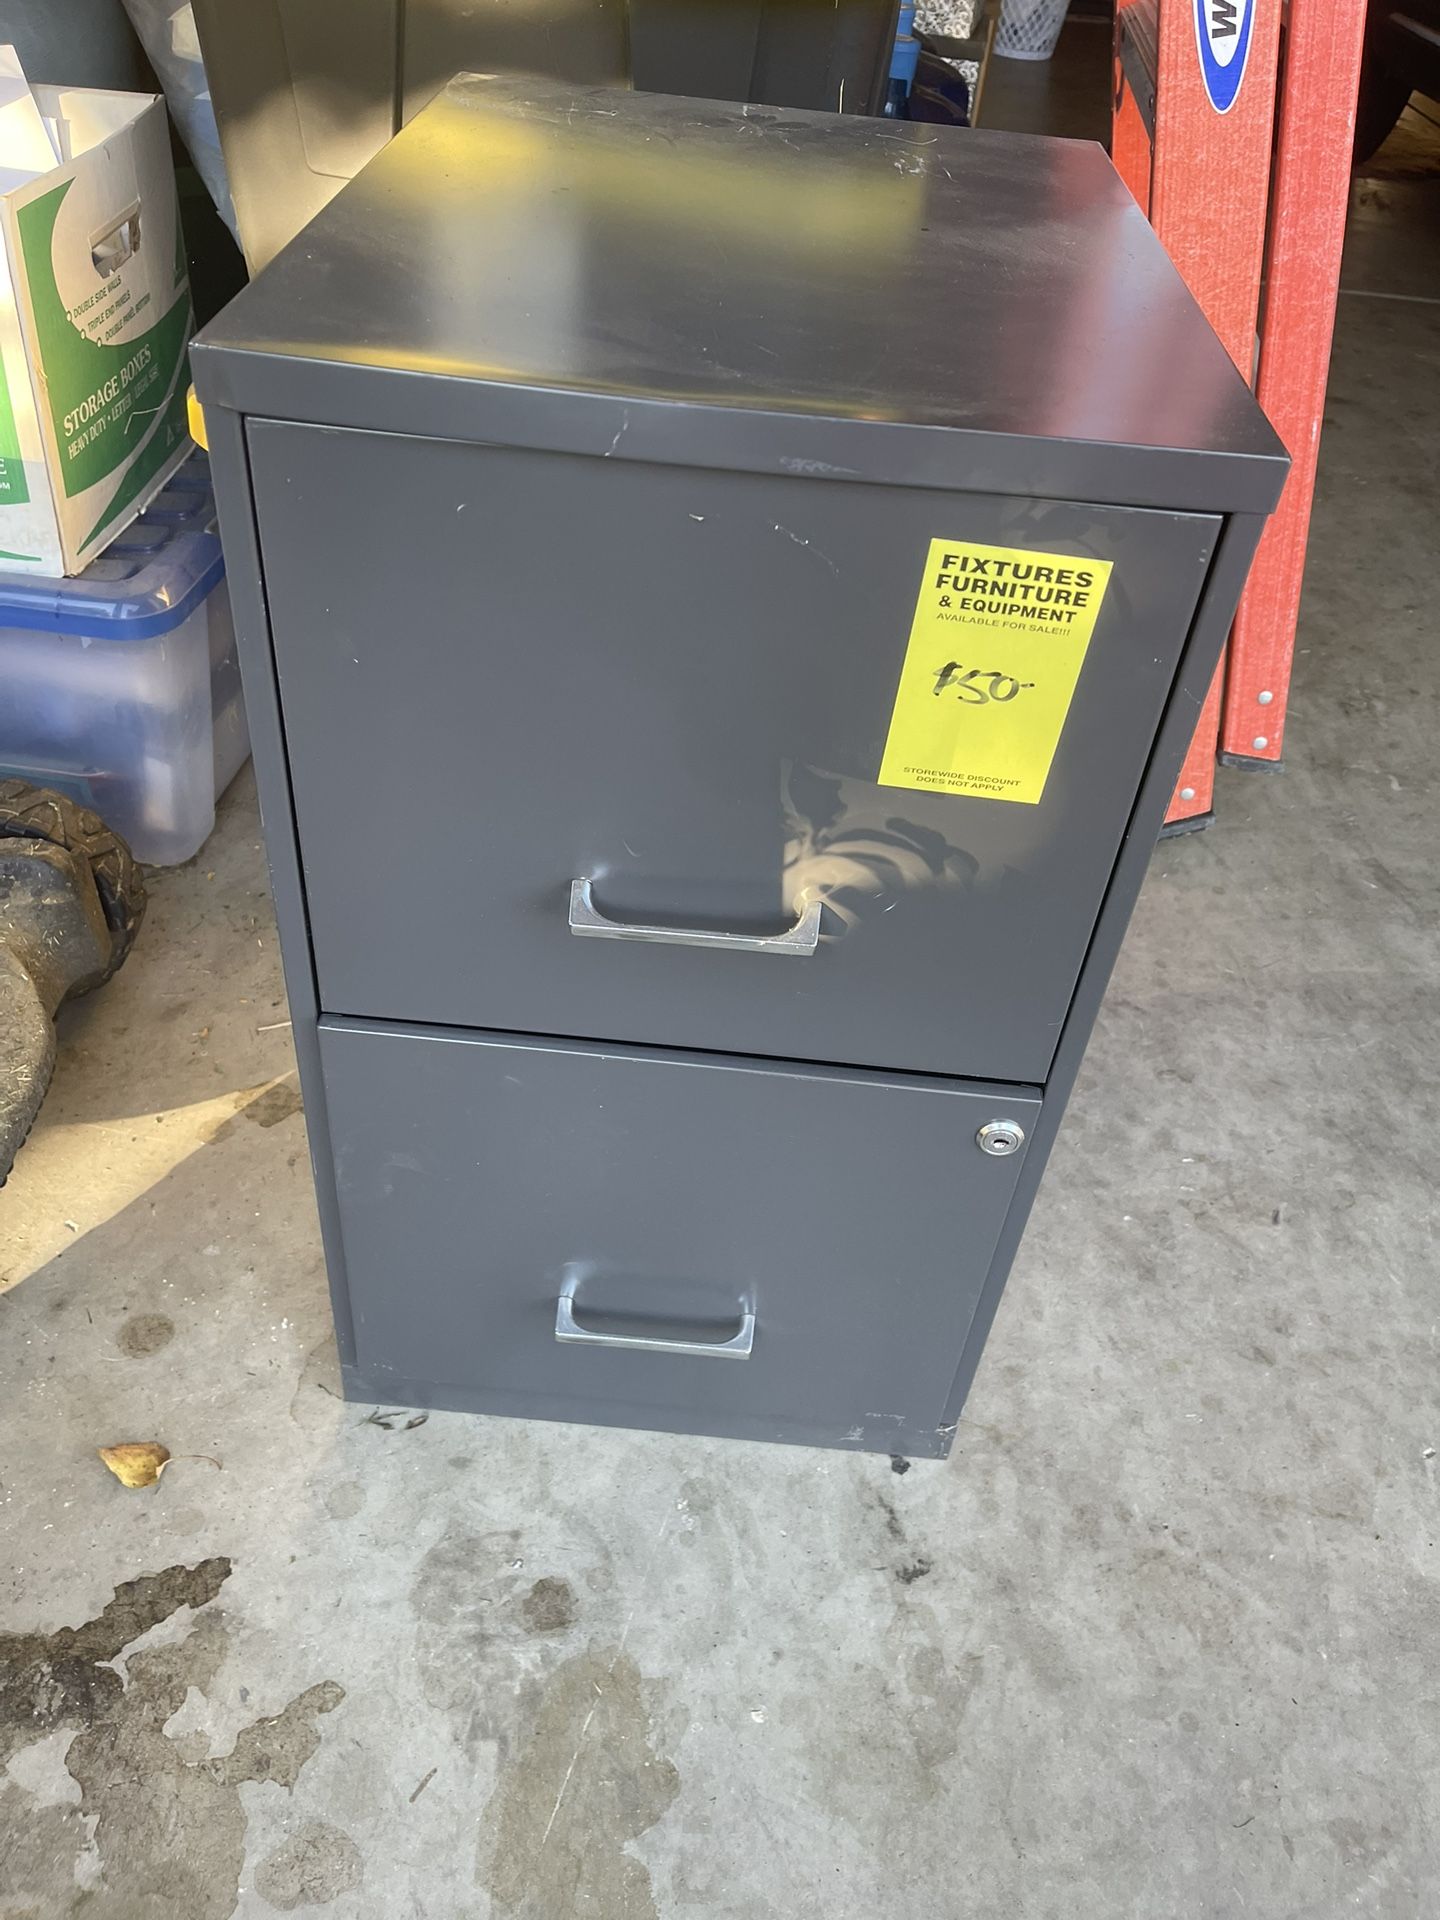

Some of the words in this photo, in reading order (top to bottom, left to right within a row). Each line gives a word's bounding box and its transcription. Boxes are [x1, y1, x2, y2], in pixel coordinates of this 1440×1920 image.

[73, 296, 95, 318] DOUBLE
[95, 287, 107, 303] SIDE
[107, 275, 121, 293] WALLS
[88, 312, 104, 332] TRIPLE
[105, 305, 115, 319] END
[105, 319, 123, 341] DOUBLE
[63, 376, 119, 437] STORAGE
[120, 343, 151, 388] BOXES
[68, 434, 89, 460] HEAVY
[90, 417, 107, 441] DUTY
[111, 393, 132, 421] LETTER
[941, 554, 1094, 588] FIXTURES
[936, 574, 1090, 608] FURNITURE
[938, 595, 952, 608] &
[960, 597, 1077, 623] EQUIPMENT
[936, 612, 999, 627] AVAILABLE
[1002, 621, 1026, 631] FOR
[1029, 624, 1071, 637] SALE!!!
[903, 766, 965, 780] STOREWIDE
[967, 774, 1021, 786] DISCOUNT
[916, 776, 945, 785] DOES
[947, 779, 969, 788] NOT
[970, 782, 1004, 792] APPLY
